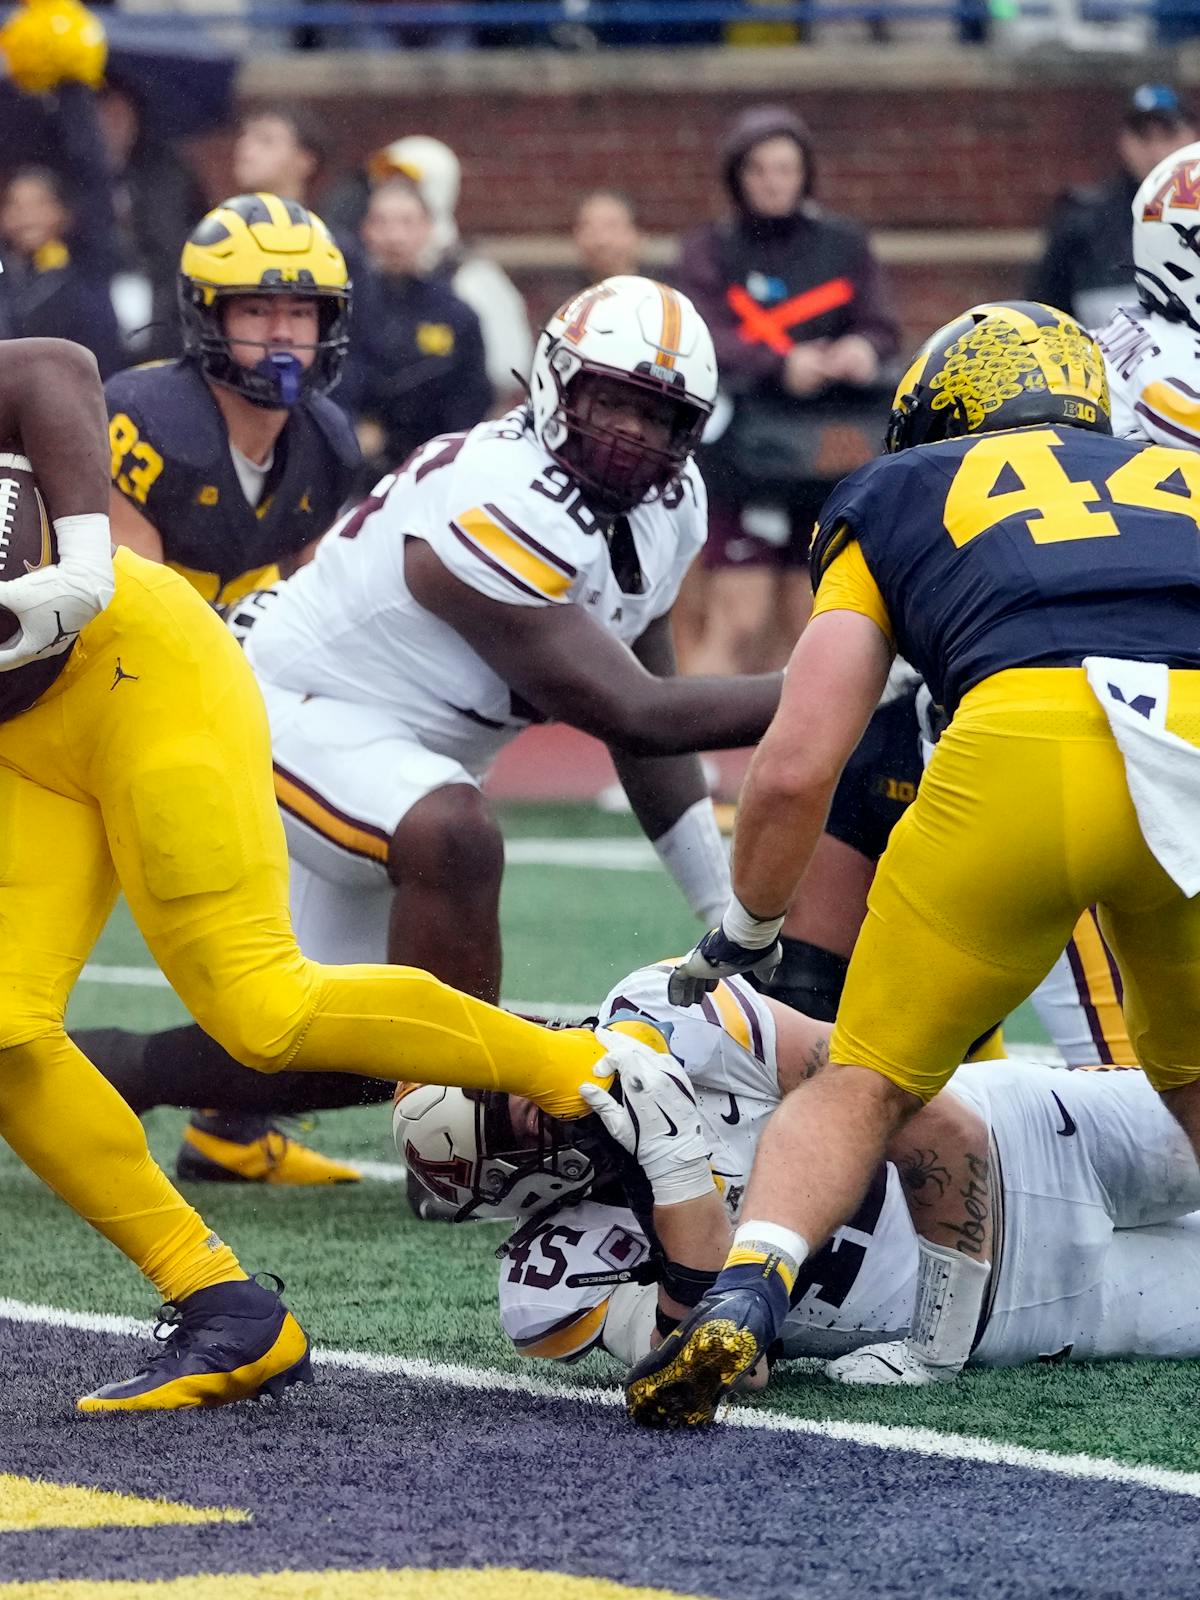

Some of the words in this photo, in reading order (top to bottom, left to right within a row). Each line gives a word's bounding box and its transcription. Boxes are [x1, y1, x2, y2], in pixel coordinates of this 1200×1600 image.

[108, 412, 165, 505] 83
[942, 429, 1200, 549] 44
[507, 1222, 588, 1291] 45
[577, 1273, 619, 1285] BREG
